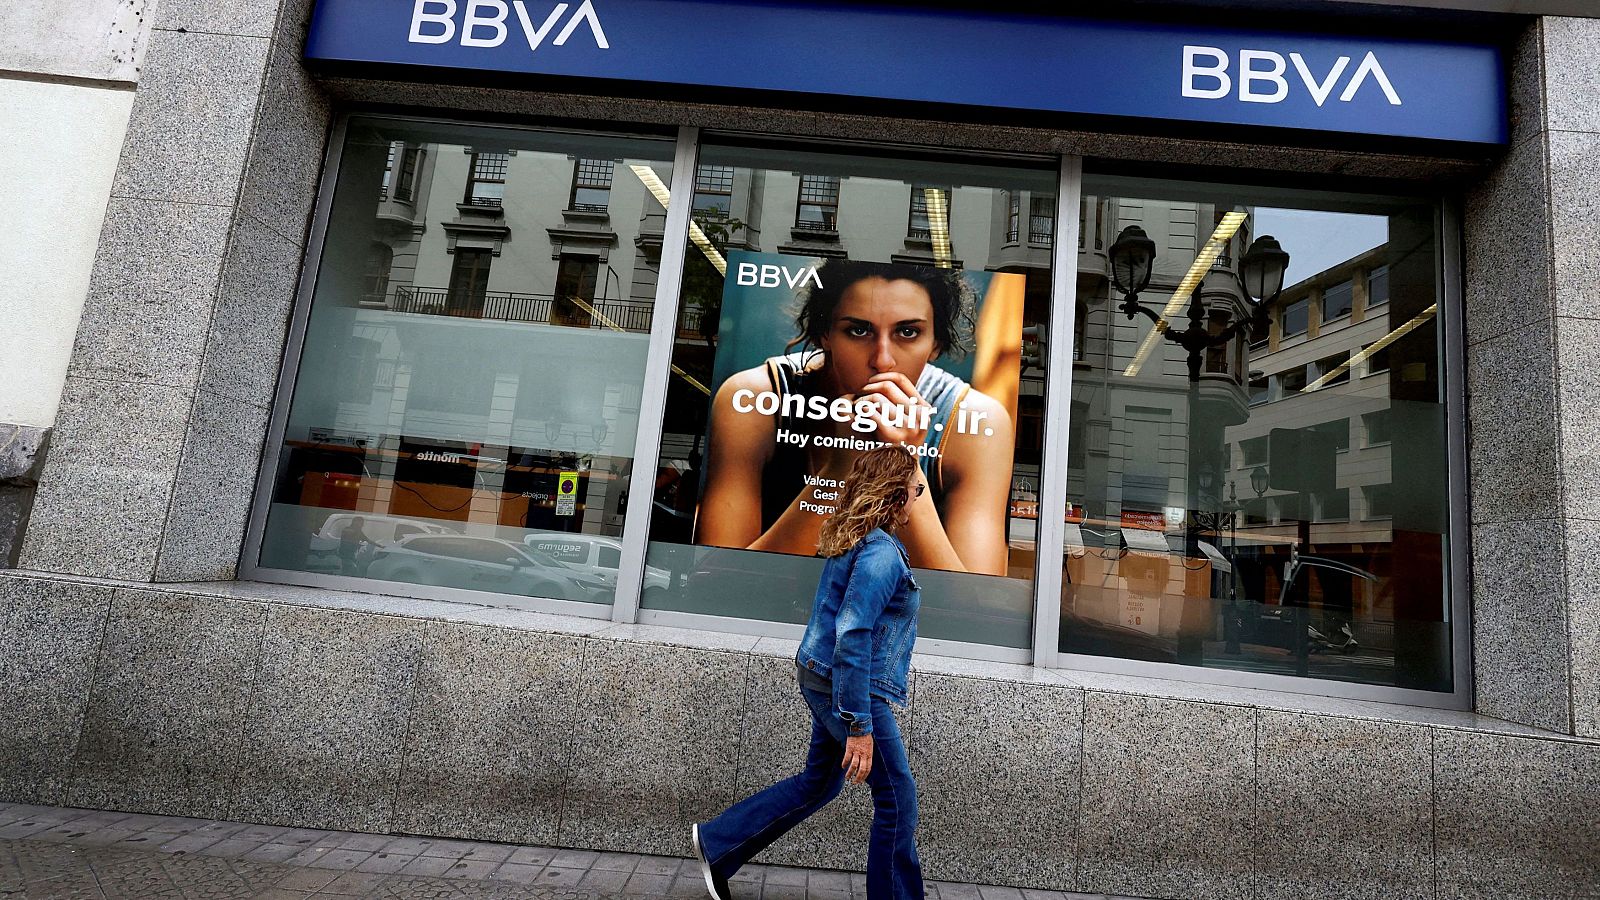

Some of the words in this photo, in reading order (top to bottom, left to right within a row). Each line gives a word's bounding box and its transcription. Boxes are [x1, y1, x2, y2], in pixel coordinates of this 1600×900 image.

[408, 0, 610, 51] BBVA
[1181, 45, 1402, 107] BBVA
[736, 262, 824, 290] BBVA
[731, 388, 944, 433] conseguir.
[956, 401, 994, 437] ir.
[776, 428, 810, 448] Hoy
[803, 474, 837, 488] Valora
